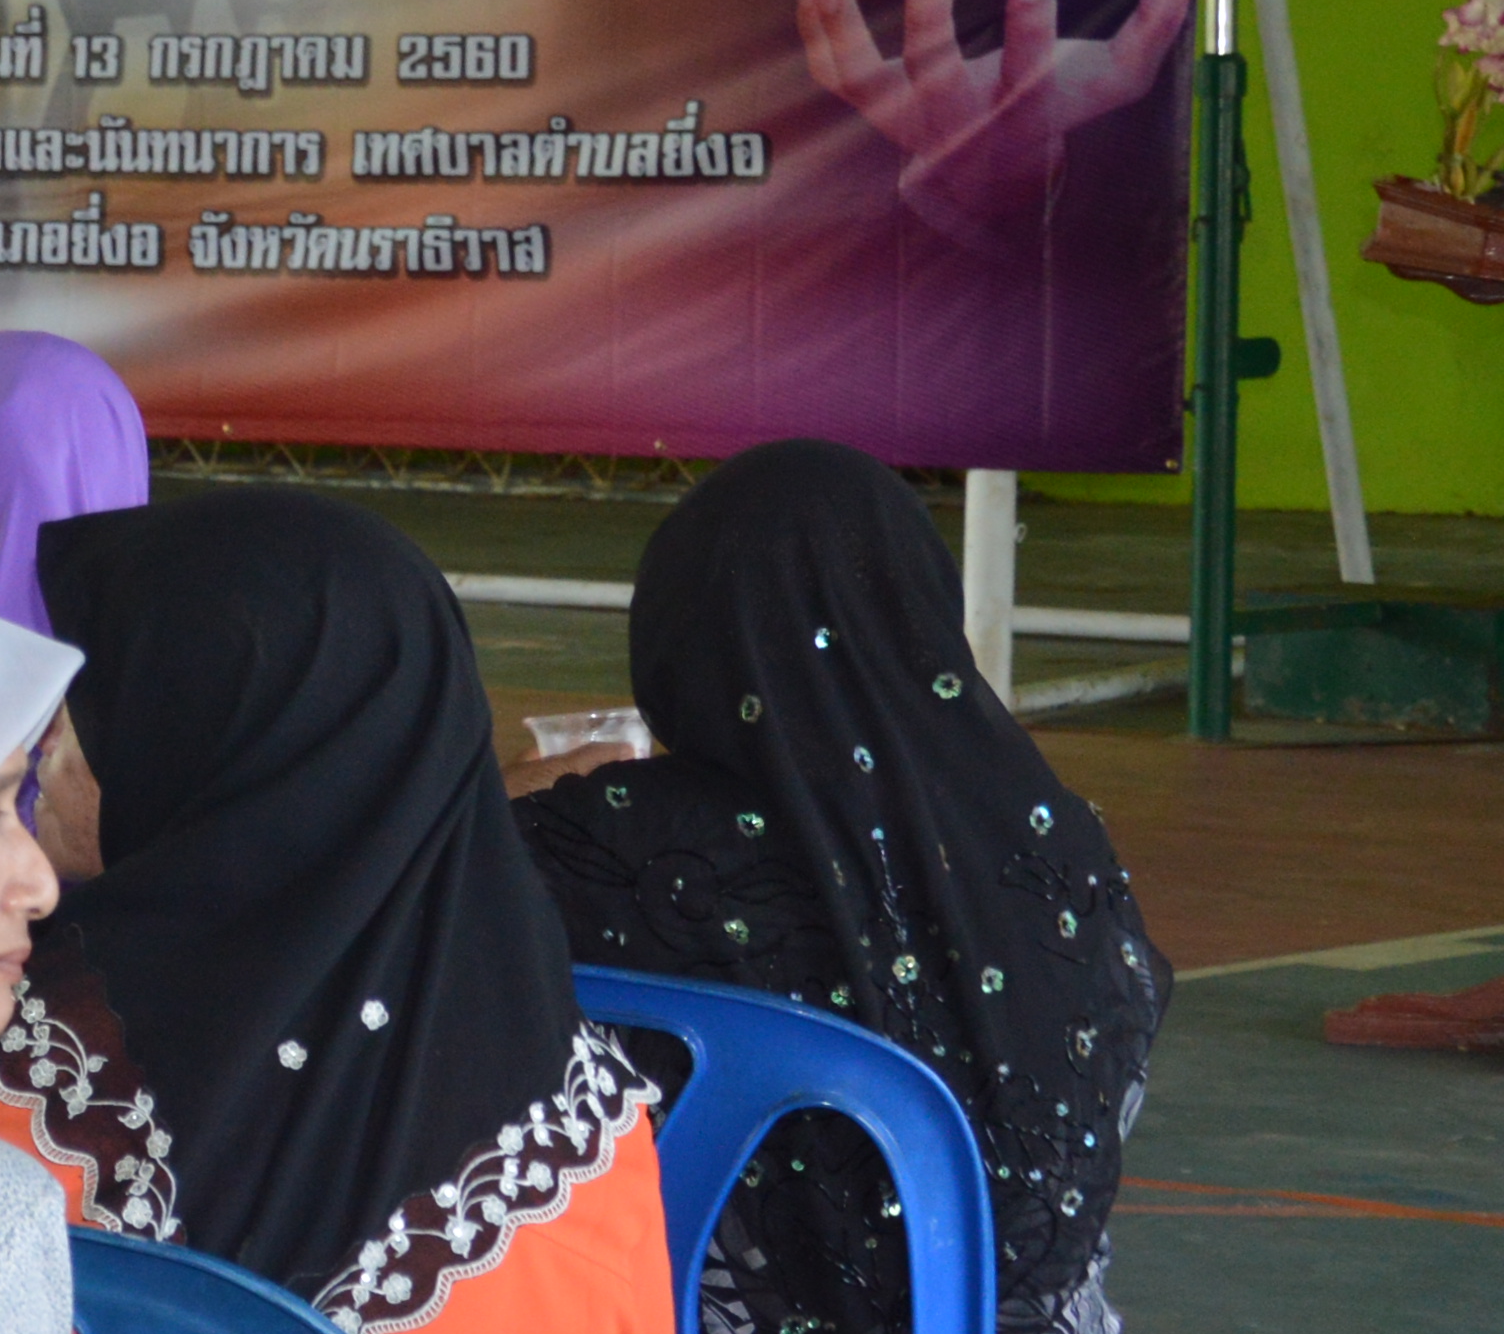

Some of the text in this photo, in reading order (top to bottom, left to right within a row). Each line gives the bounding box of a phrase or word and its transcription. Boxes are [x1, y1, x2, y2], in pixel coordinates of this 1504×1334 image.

[71, 35, 121, 79] 13
[149, 34, 366, 91] กรกฎาคม
[397, 34, 531, 79] 2560
[351, 99, 767, 178] เทศบาลตำบลยี่งอ
[188, 213, 548, 273] จังหวัดนราธิวาส
